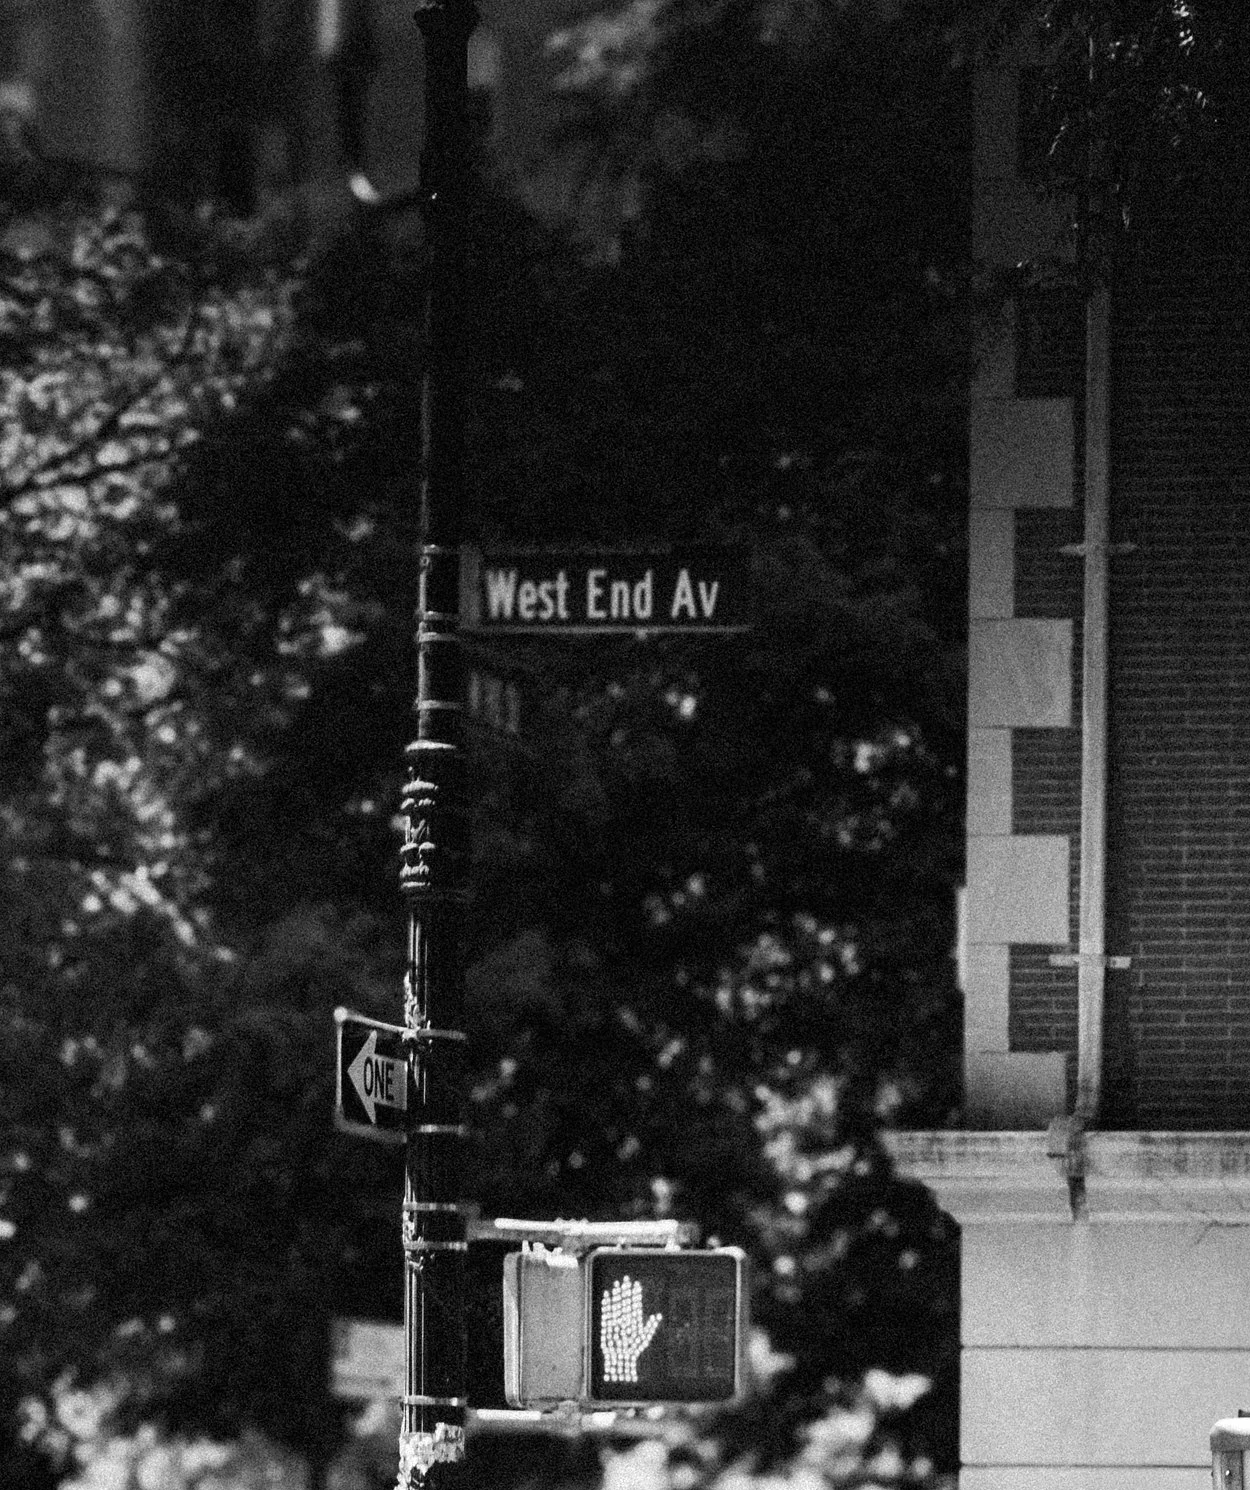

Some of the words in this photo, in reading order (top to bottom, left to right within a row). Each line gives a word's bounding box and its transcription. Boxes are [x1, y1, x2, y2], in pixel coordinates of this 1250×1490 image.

[486, 568, 570, 620] West
[586, 568, 653, 620] End
[670, 568, 719, 619] Av
[363, 1056, 395, 1101] ONE
